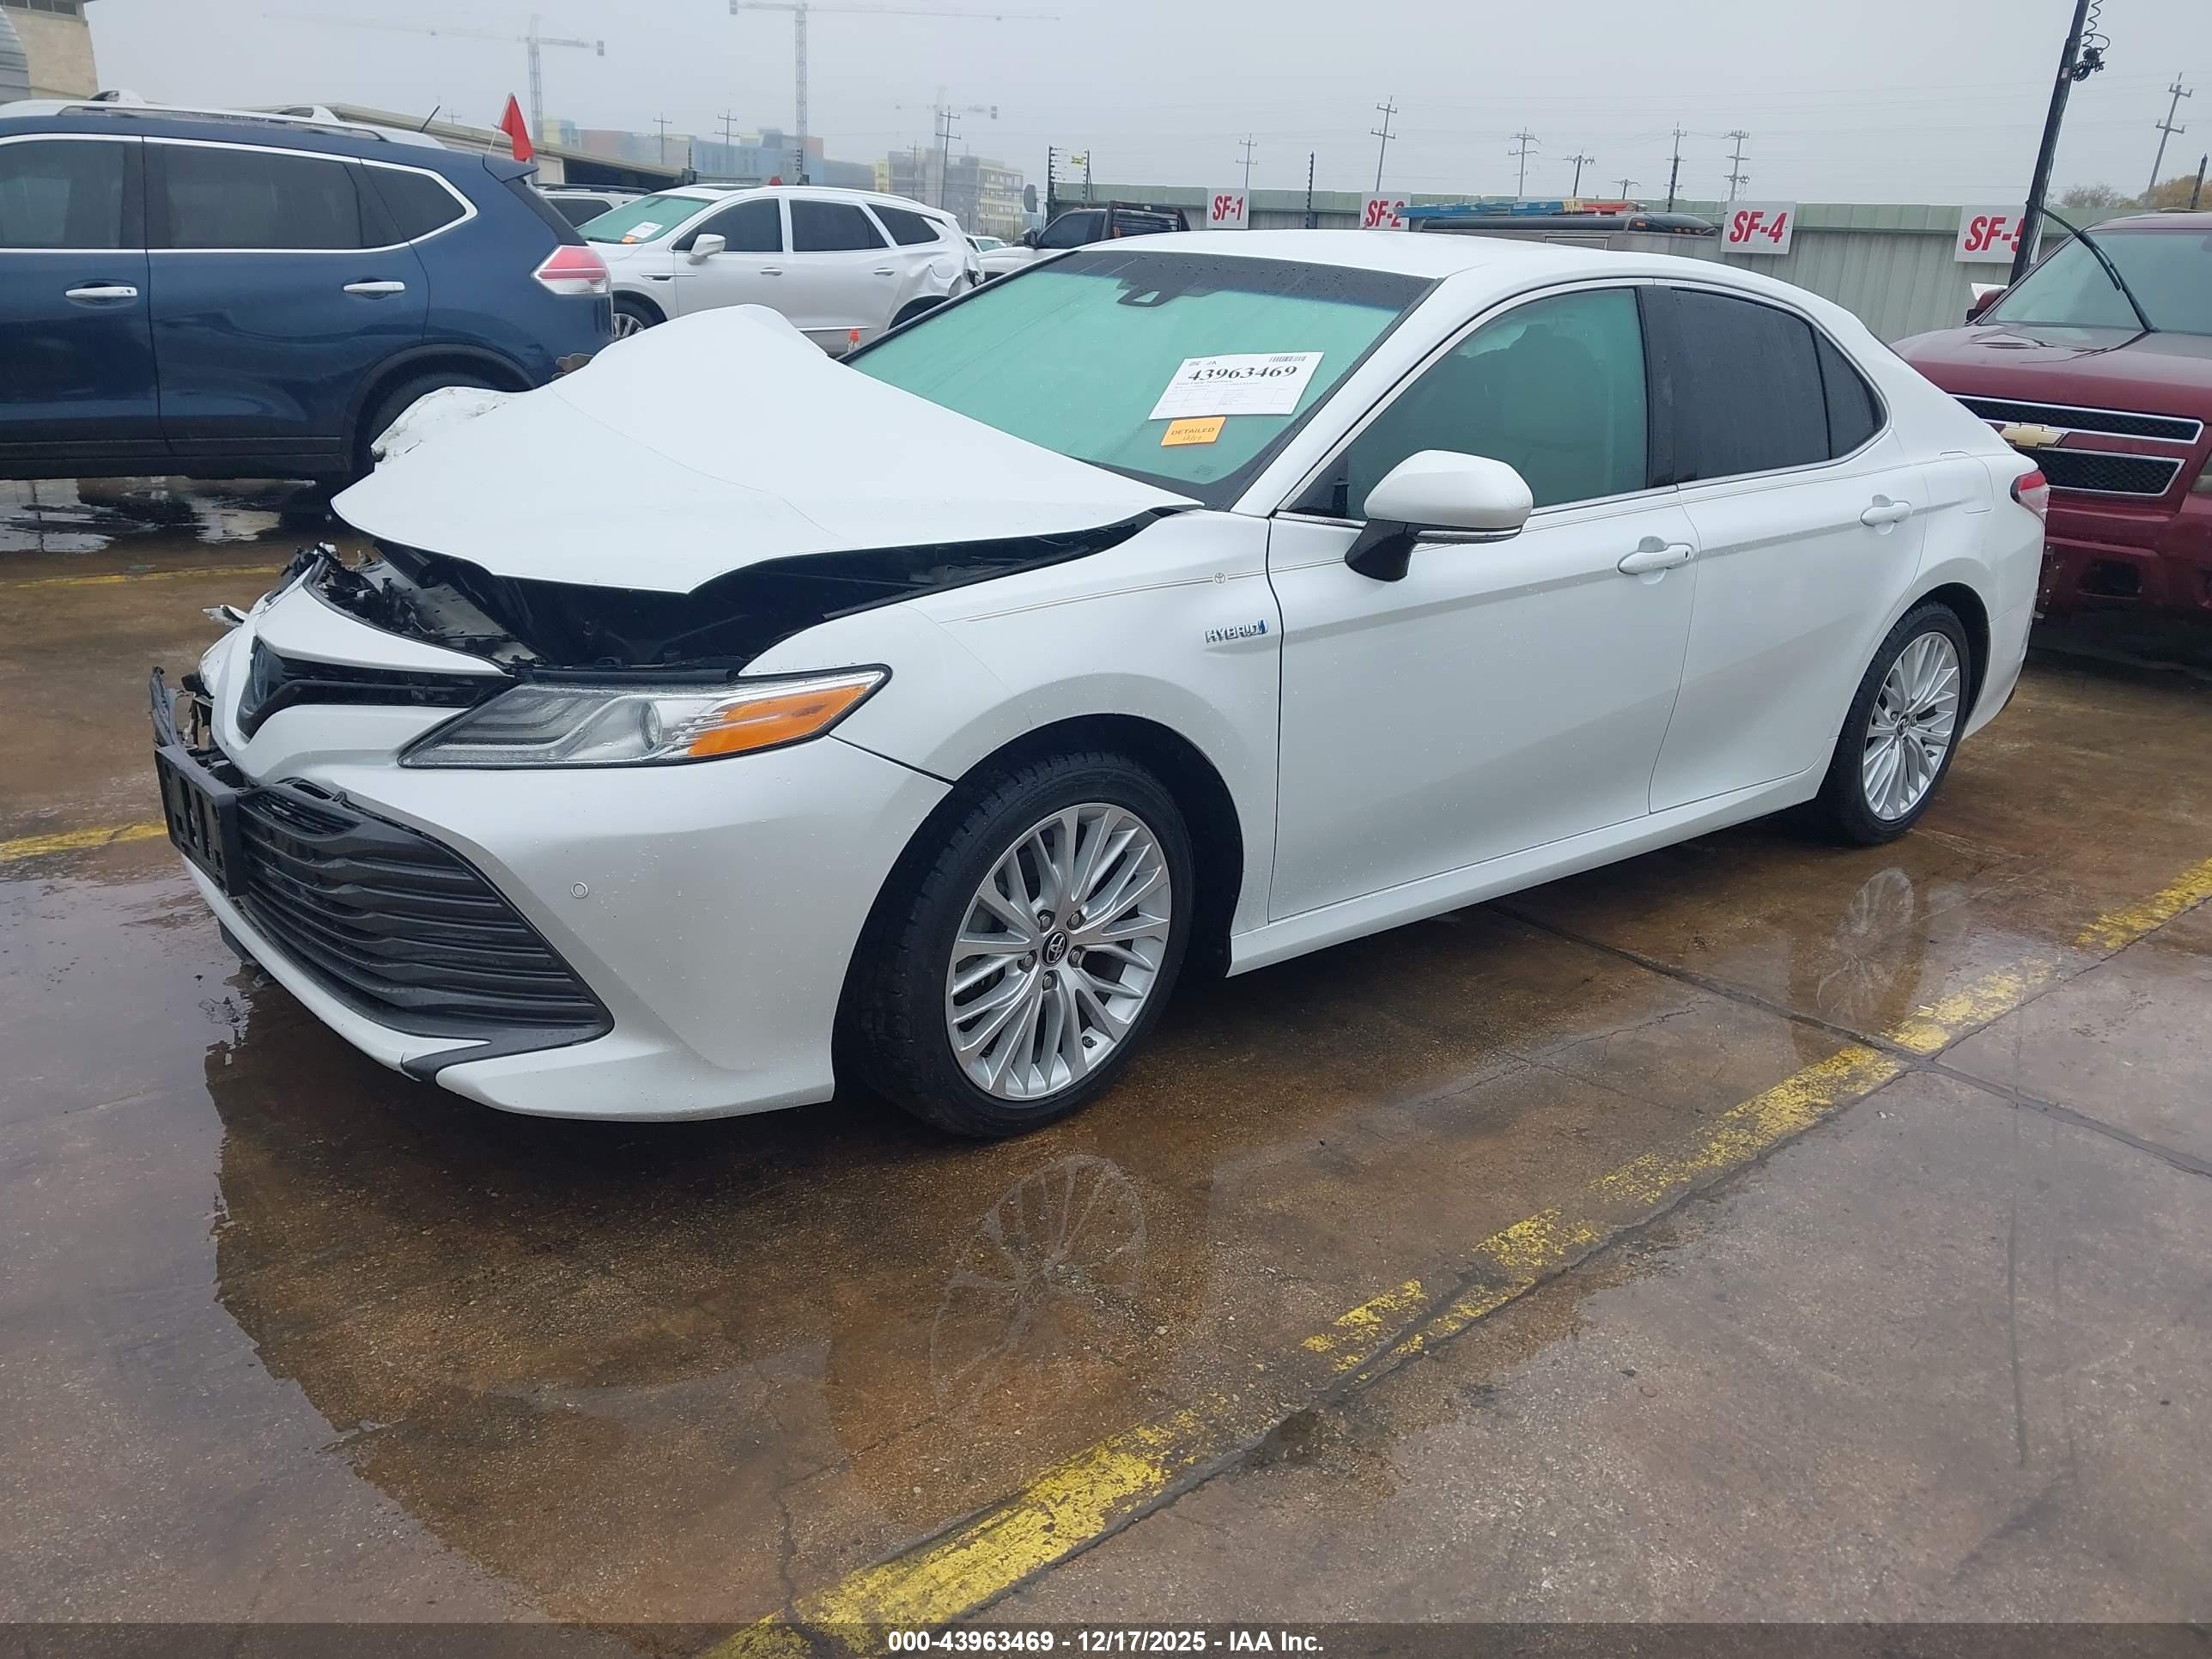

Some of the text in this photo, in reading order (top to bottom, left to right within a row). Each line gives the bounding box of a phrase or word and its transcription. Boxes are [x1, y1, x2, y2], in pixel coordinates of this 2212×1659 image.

[1212, 195, 1243, 221] SF-1
[1364, 199, 1406, 228] SF-2
[1729, 210, 1788, 244] SF-4
[1188, 366, 1297, 381] 43963469
[1170, 427, 1215, 435] DETAILED
[1205, 624, 1259, 644] HYBRID
